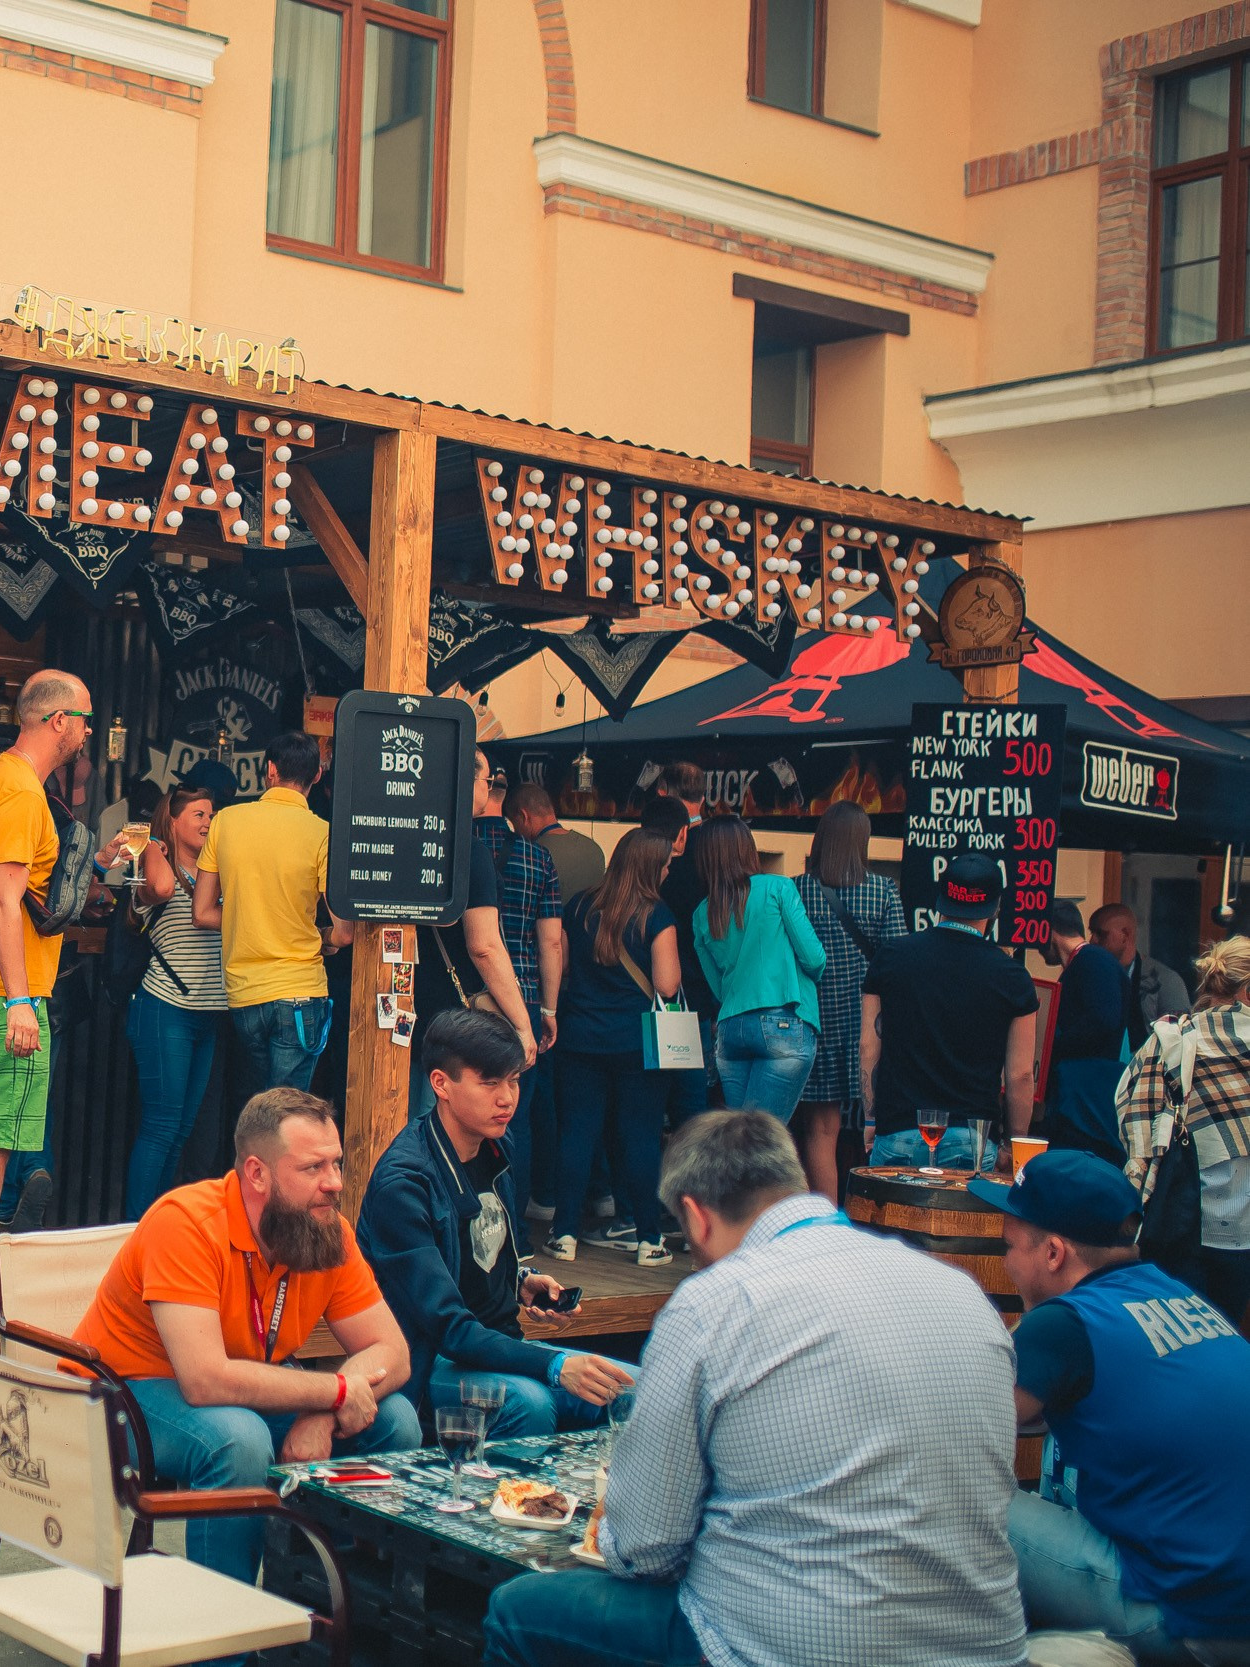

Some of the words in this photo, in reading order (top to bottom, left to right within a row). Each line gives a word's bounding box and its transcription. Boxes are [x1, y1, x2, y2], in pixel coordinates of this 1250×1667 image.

[78, 546, 109, 561] BBQ
[476, 457, 936, 645] WHISKEY
[170, 607, 197, 628] BBQ
[429, 626, 454, 649] BBQ
[175, 665, 216, 701] JACK
[219, 657, 282, 711] DANIEL'S
[217, 697, 249, 741] &
[942, 708, 1038, 737] СТЕЙКИ
[382, 728, 399, 743] JACK
[912, 736, 947, 755] NEW
[952, 738, 992, 758] YORK
[380, 752, 424, 780] BBQ
[1003, 740, 1052, 776] 500
[912, 759, 965, 780] FLANK
[386, 781, 416, 797] DRINKS
[930, 786, 1033, 817] БУРГЕРЫ
[351, 815, 387, 827] LYNCHBURG
[388, 817, 419, 829] LEMONADE
[423, 815, 438, 830] 250
[909, 815, 983, 834] КЛАССИКА
[908, 832, 958, 849] PULLED
[968, 833, 1006, 850] PORK
[1013, 818, 1056, 850] 300
[351, 842, 371, 854] FATTY
[371, 843, 395, 855] MAGGIE
[422, 842, 437, 858] 200
[372, 870, 392, 882] HONEY
[421, 869, 436, 884] 200
[1015, 860, 1053, 886] 350
[948, 882, 967, 894] BAR
[948, 891, 987, 902] STREET
[1015, 890, 1048, 911] 300
[1011, 919, 1050, 944] 200
[270, 1281, 287, 1332] BARSTREET
